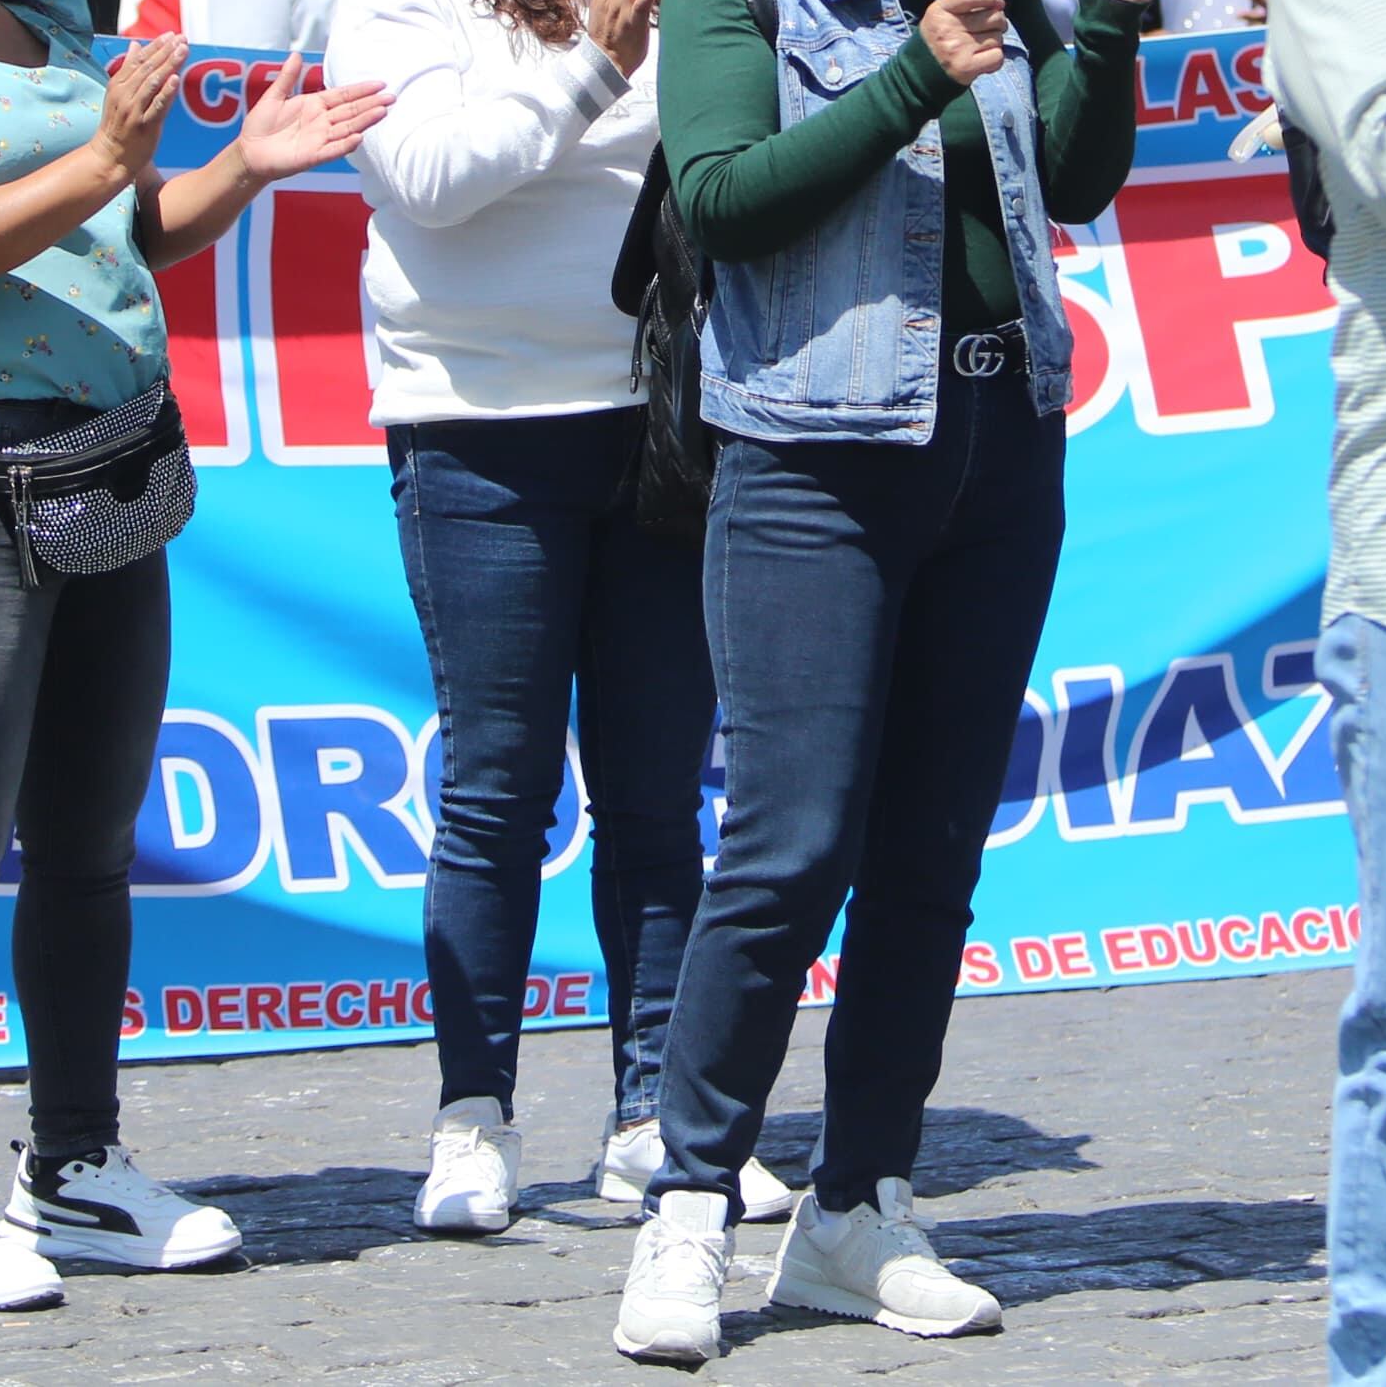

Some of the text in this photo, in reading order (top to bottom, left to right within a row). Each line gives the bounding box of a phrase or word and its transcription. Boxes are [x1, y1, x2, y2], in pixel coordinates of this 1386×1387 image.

[1015, 933, 1093, 982] DE
[1103, 905, 1362, 973] EDUCACI
[522, 973, 592, 1018] DE
